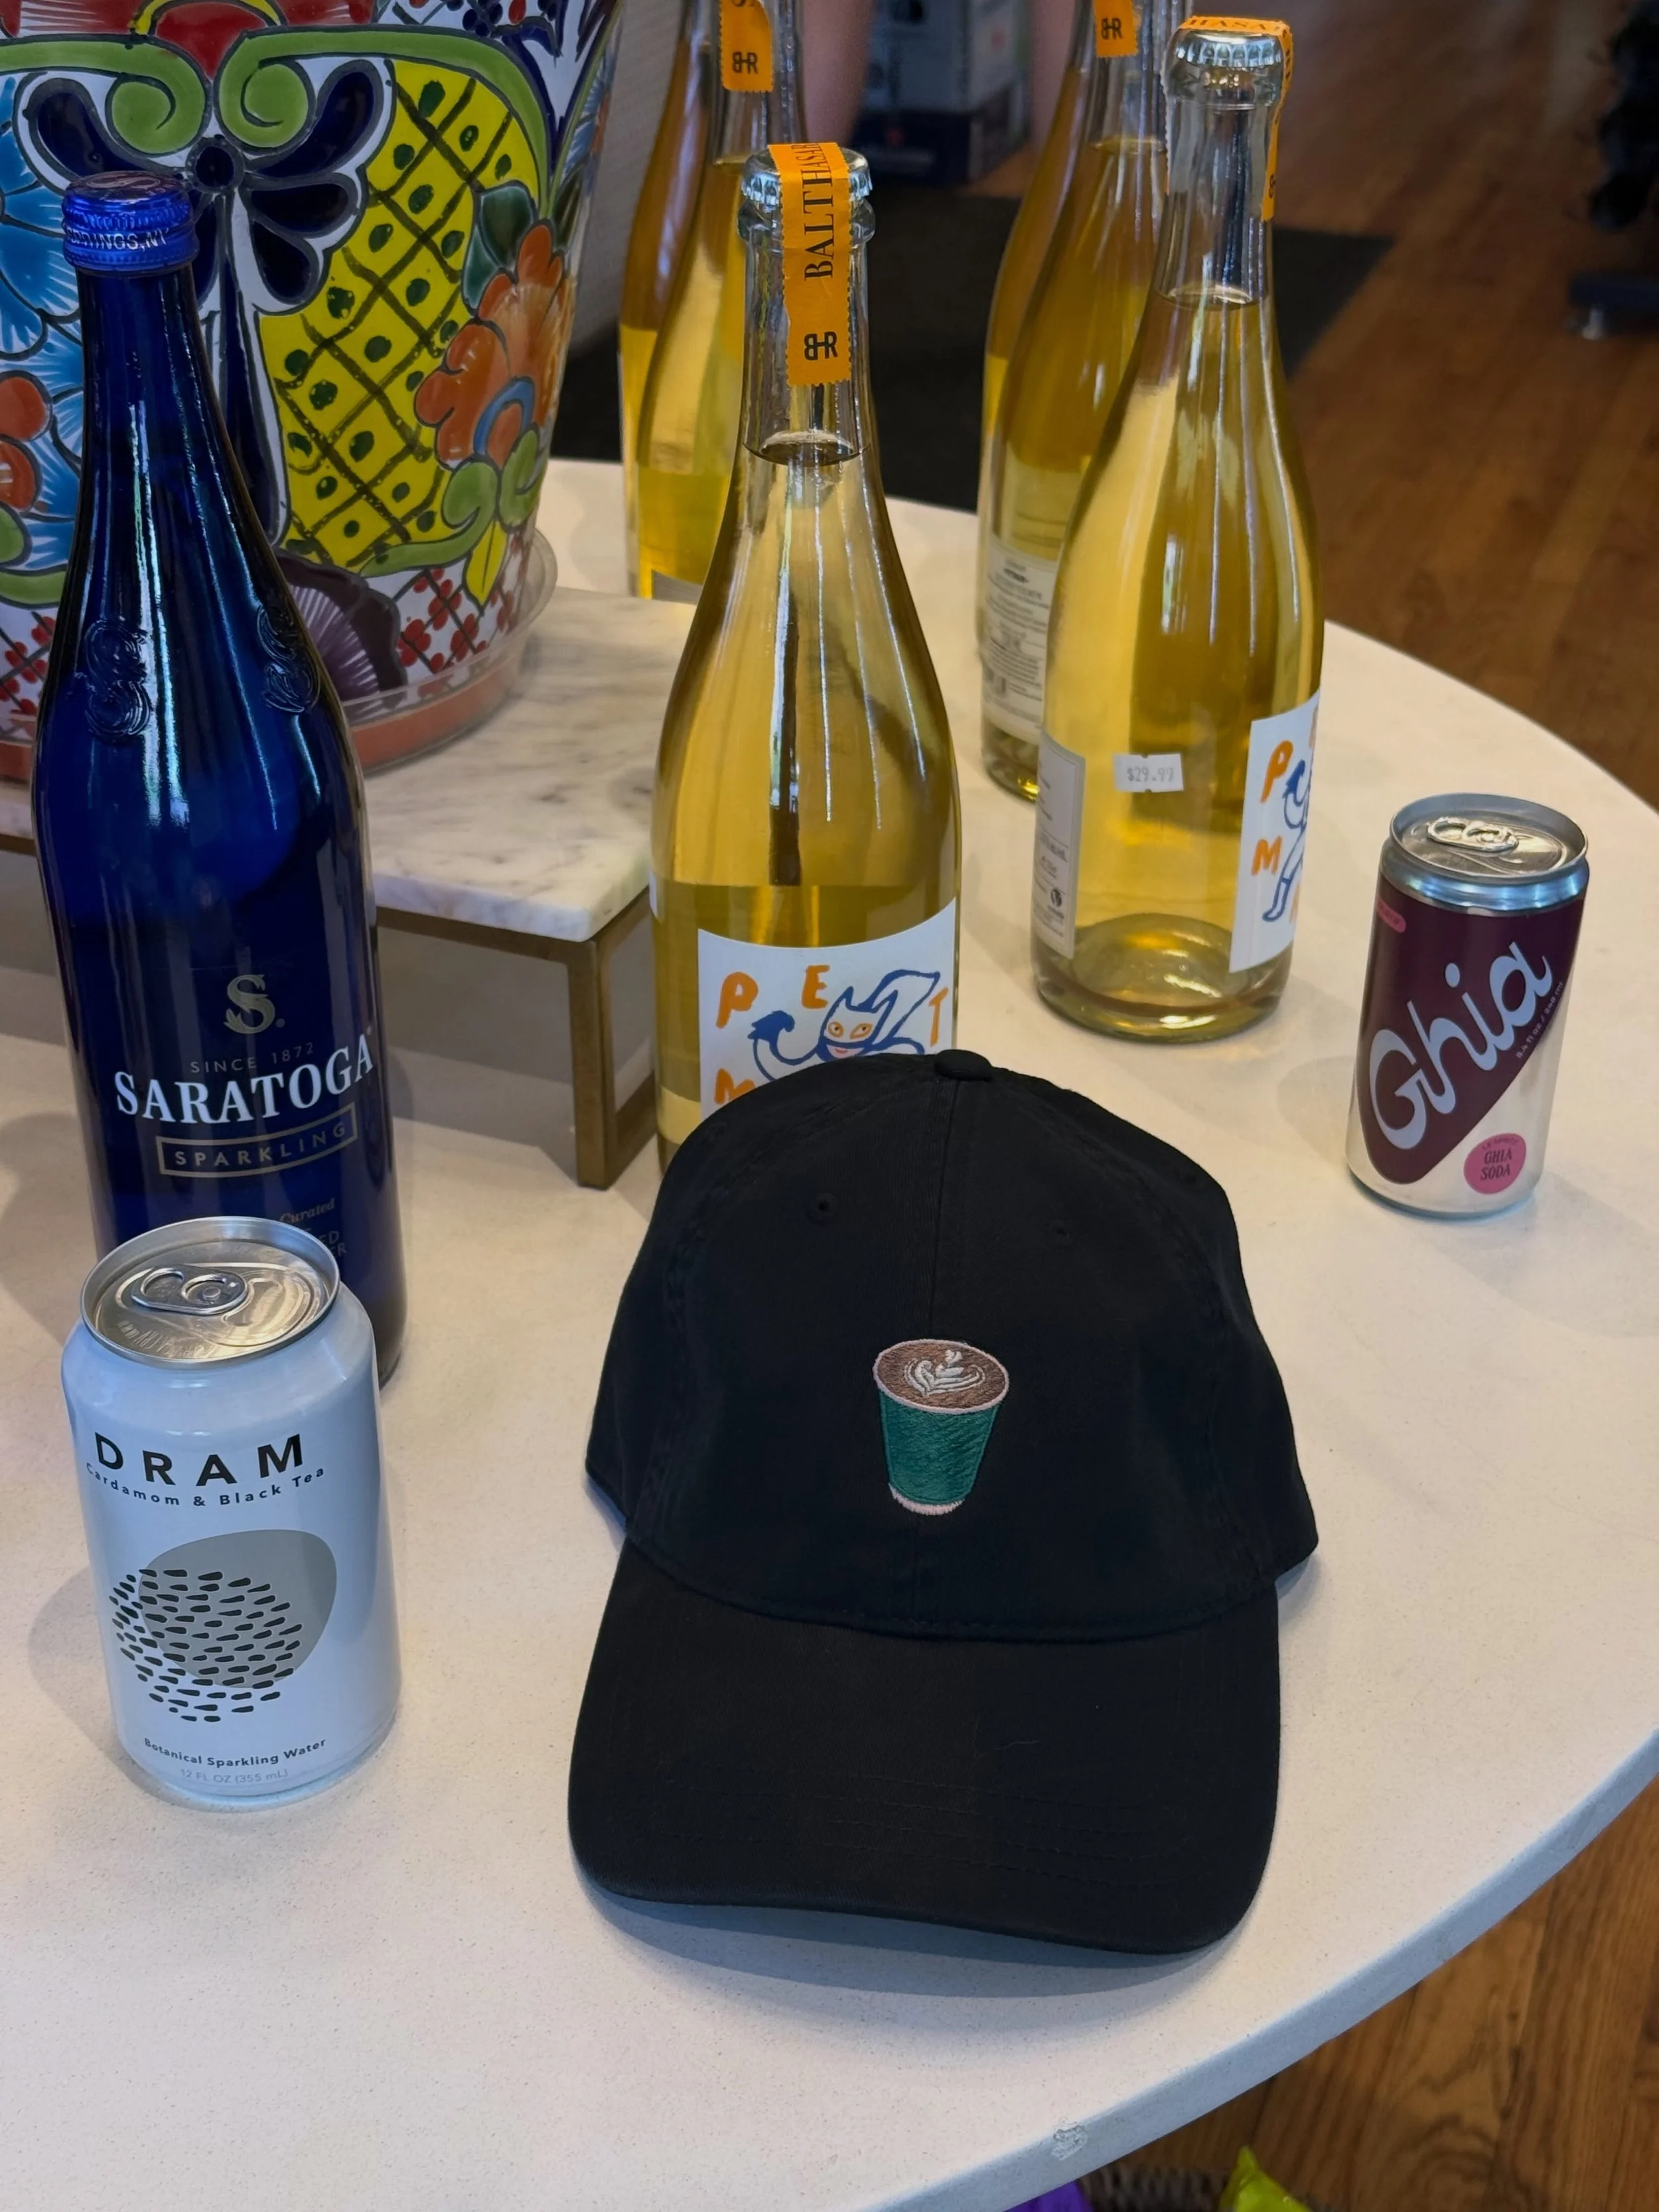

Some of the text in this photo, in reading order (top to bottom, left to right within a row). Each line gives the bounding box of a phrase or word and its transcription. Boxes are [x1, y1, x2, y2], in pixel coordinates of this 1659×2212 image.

[1127, 767, 1175, 783] $29.99
[190, 1042, 315, 1074] SINCE 1872
[1369, 941, 1553, 1150] Ghia
[113, 1033, 374, 1124] SARATOGA
[174, 1121, 347, 1167] SPARKLING
[1484, 1147, 1512, 1165] GHIA
[1480, 1163, 1510, 1181] SODA
[94, 1432, 304, 1487] DRAM
[86, 1462, 325, 1507] Cardamom & Black Tea
[144, 1737, 327, 1768] Botanical Sparkling Water
[180, 1768, 289, 1785] 12 FL OZ (355 mL)
